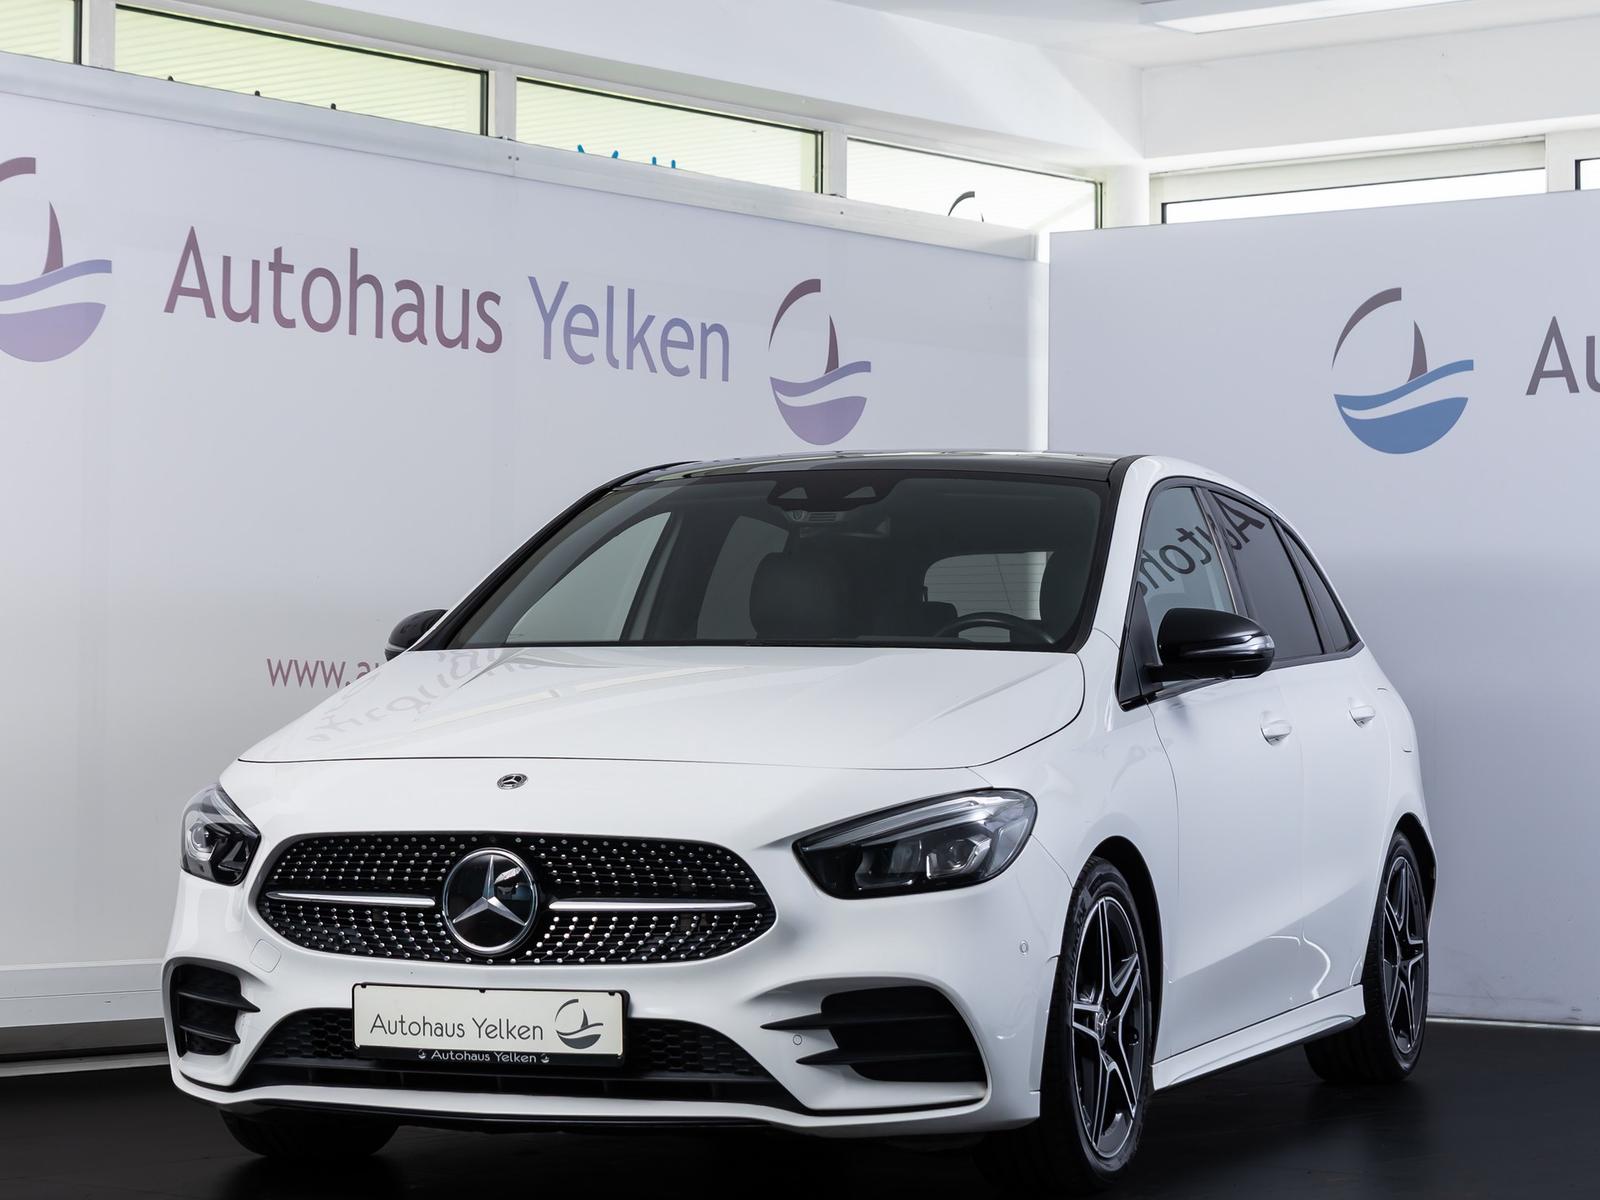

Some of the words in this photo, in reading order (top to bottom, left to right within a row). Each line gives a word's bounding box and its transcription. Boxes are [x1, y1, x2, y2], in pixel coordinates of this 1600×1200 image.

[164, 226, 503, 354] Autohaus
[528, 276, 730, 382] Yelken
[267, 658, 379, 688] www.a
[370, 1013, 465, 1038] Autohaus
[472, 1017, 544, 1041] Yelken
[431, 1050, 490, 1062] Autohaus
[496, 1052, 537, 1063] Yelken
